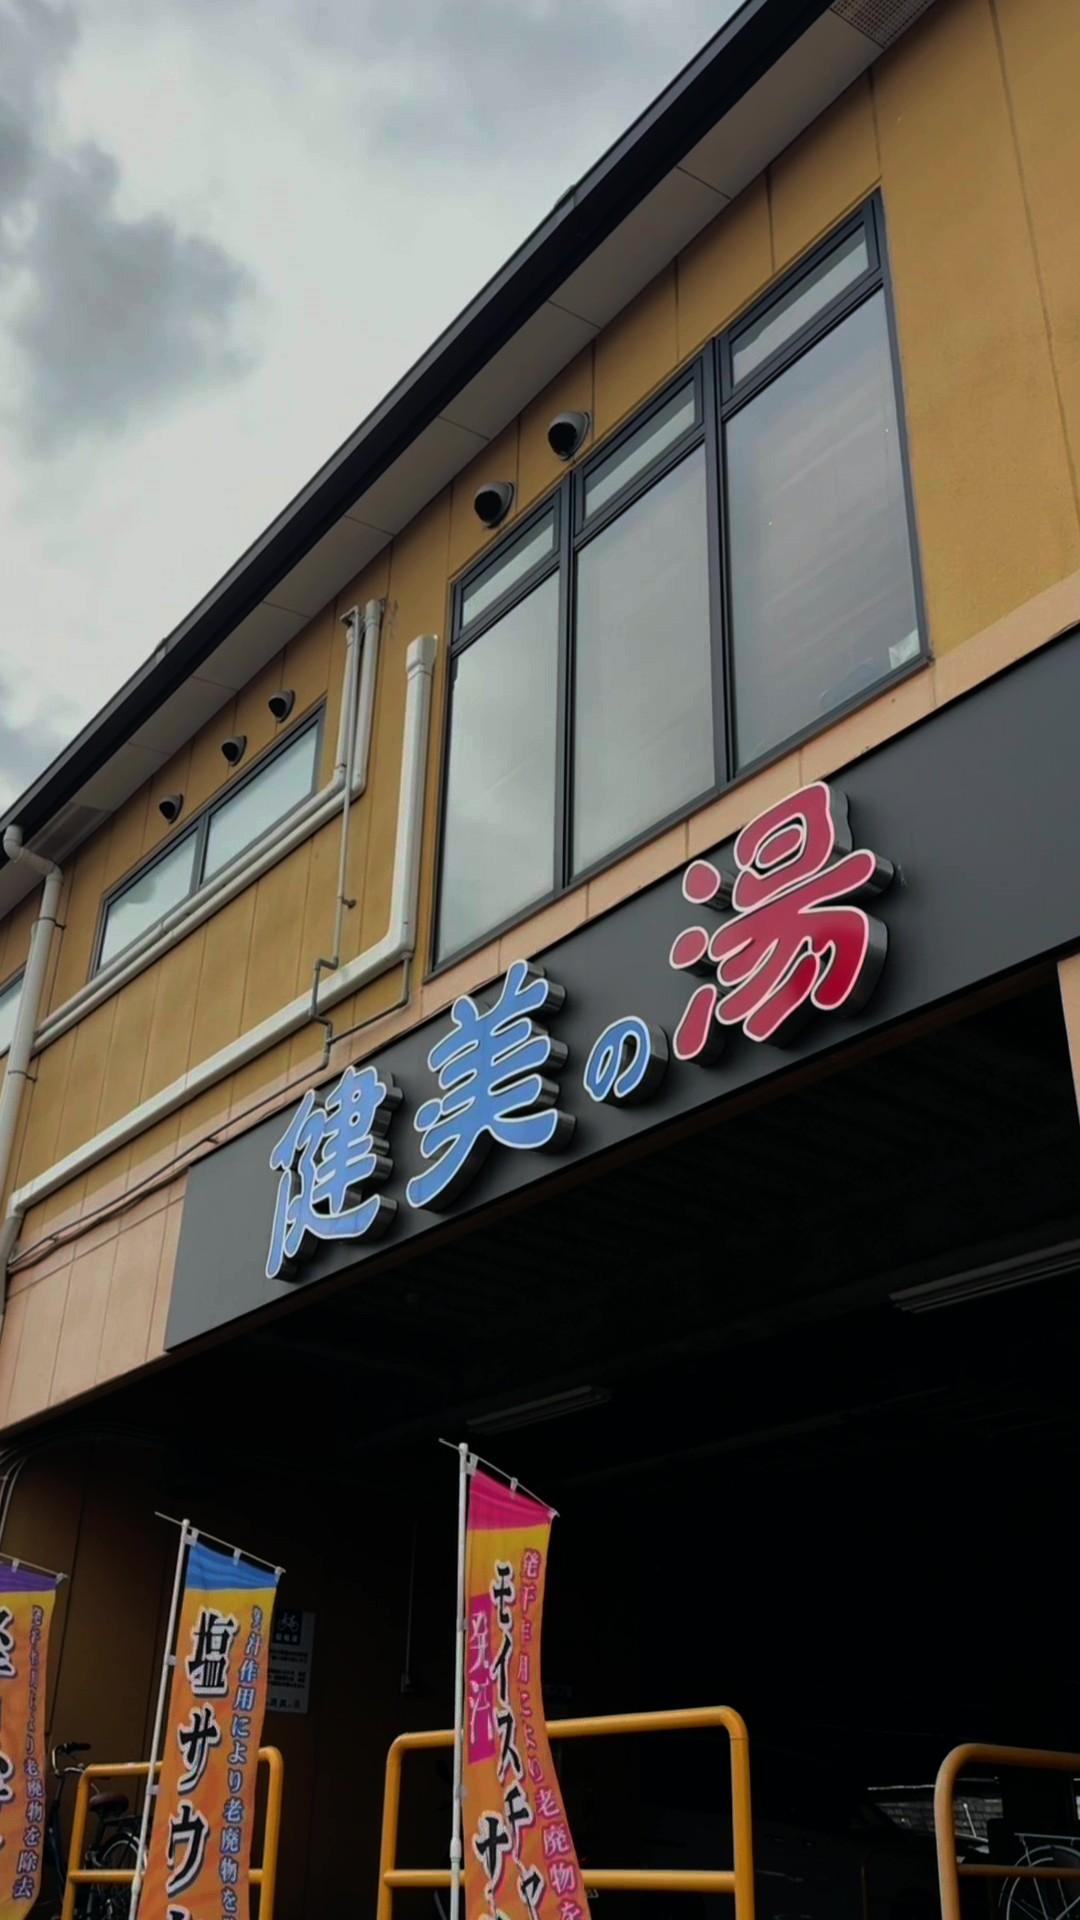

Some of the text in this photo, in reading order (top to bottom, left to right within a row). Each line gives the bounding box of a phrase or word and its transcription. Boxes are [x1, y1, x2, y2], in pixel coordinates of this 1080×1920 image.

[264, 780, 878, 1280] 健美の湯
[166, 1607, 237, 1920] 塩サウ
